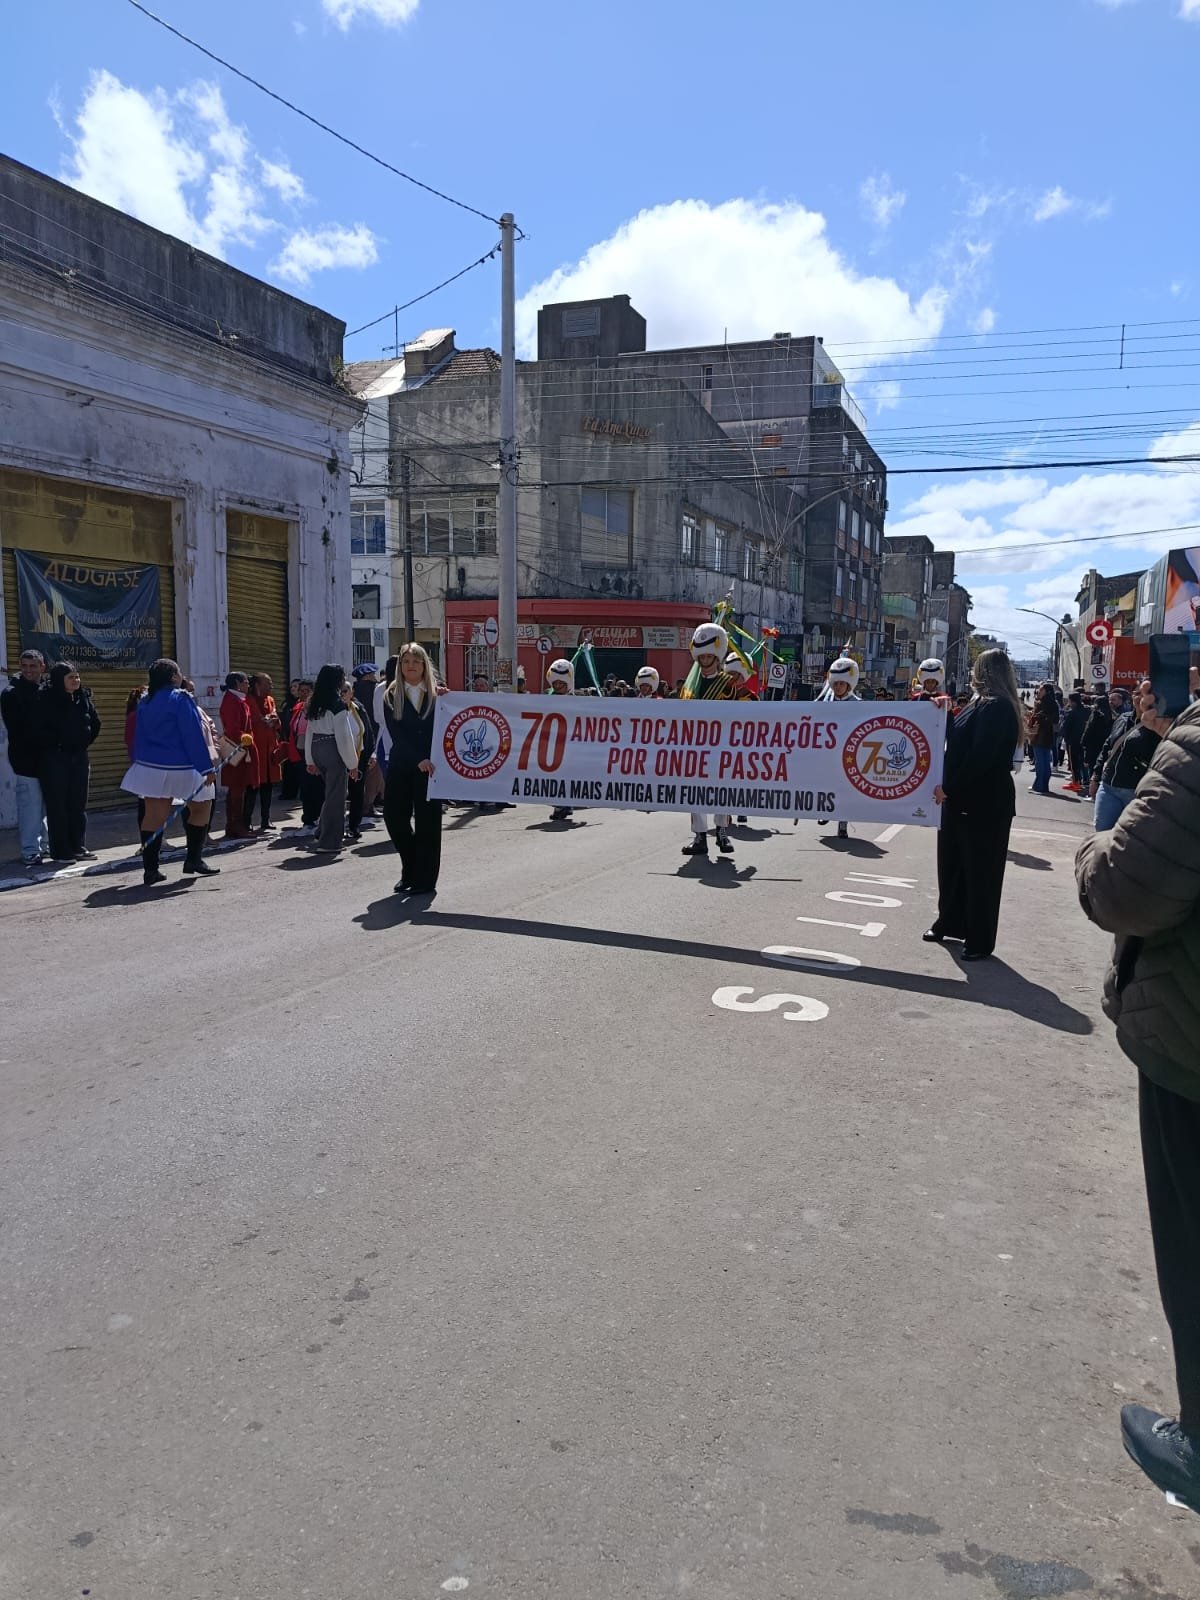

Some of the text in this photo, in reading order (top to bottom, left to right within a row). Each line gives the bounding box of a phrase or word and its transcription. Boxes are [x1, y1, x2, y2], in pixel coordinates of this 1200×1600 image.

[44, 561, 140, 588] ALUGA-SE
[593, 627, 638, 638] CELULAR
[446, 708, 510, 742] BANDA MARCIAL
[517, 711, 568, 773] 70
[570, 715, 838, 753] ANOS TOCANDO CORAÇÕES
[847, 718, 928, 757] BANDA MARCIAL
[447, 752, 507, 777] SANTANENSE
[606, 747, 788, 782] POR ONDE PASSA
[861, 741, 888, 775] 70
[511, 777, 836, 812] A BANDA MAIS ANTIGA EM FUNCIONAMENTO NO RS
[847, 766, 925, 798] SANTANENSE
